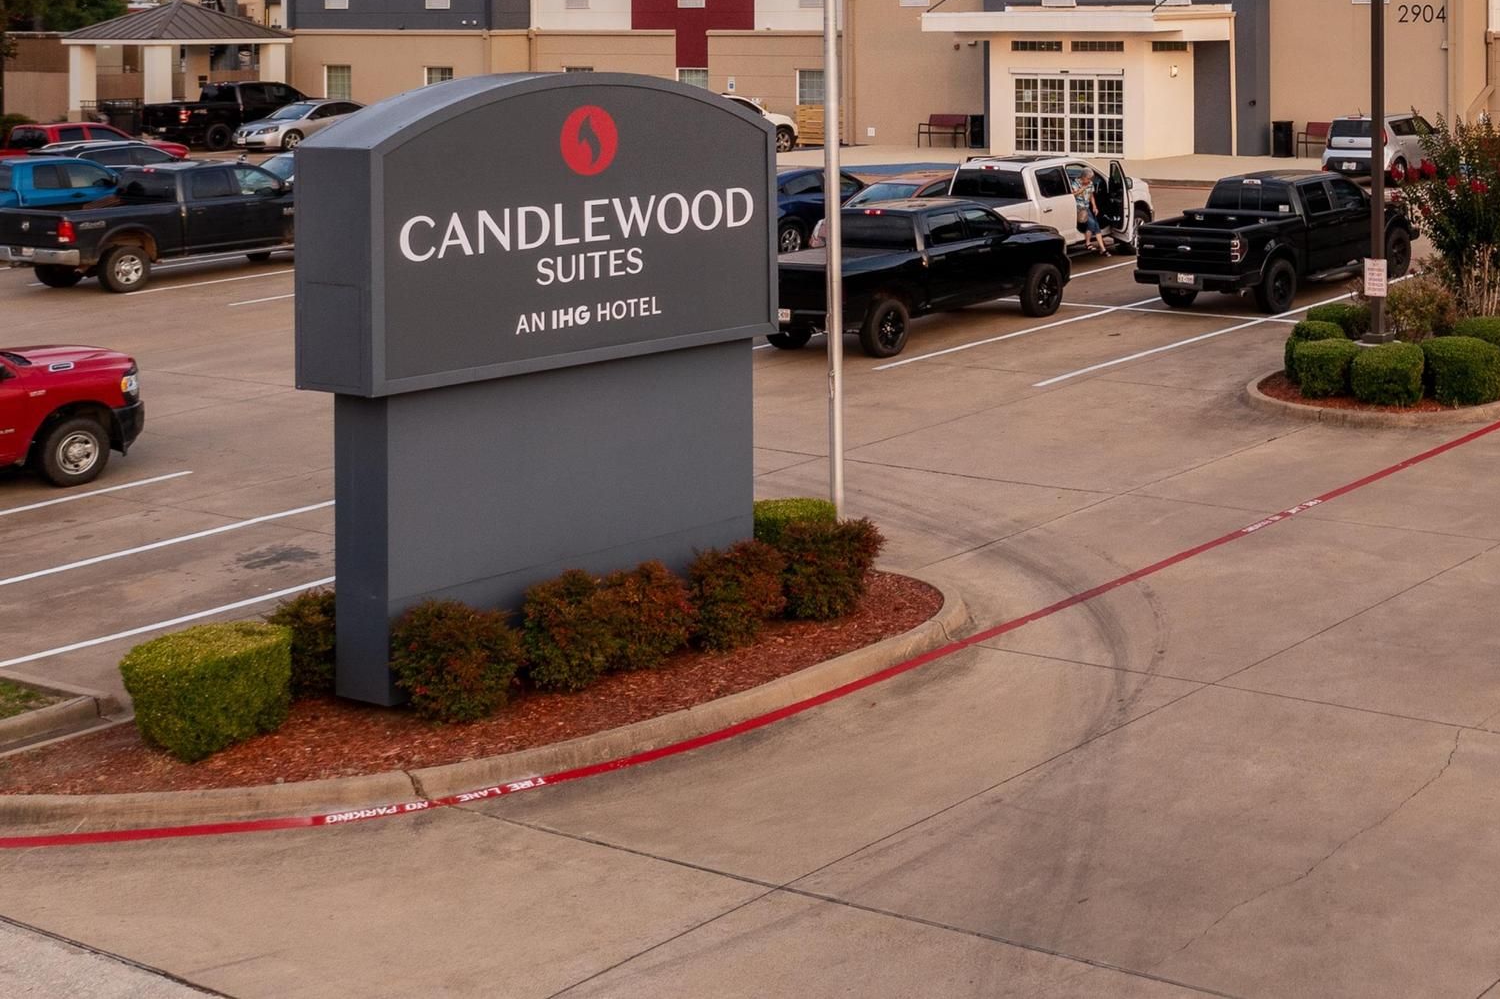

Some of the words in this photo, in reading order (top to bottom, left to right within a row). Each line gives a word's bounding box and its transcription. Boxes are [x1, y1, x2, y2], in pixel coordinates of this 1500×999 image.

[1398, 4, 1447, 23] 2904
[400, 187, 754, 262] CANDLEWOOD
[535, 247, 644, 286] SUITES
[515, 311, 545, 335] AN
[552, 305, 591, 330] IHG
[597, 296, 662, 322] HOTEL
[507, 777, 547, 792] FIRE
[456, 786, 502, 803] LANE
[325, 805, 398, 824] PARKING
[406, 800, 429, 811] NO
